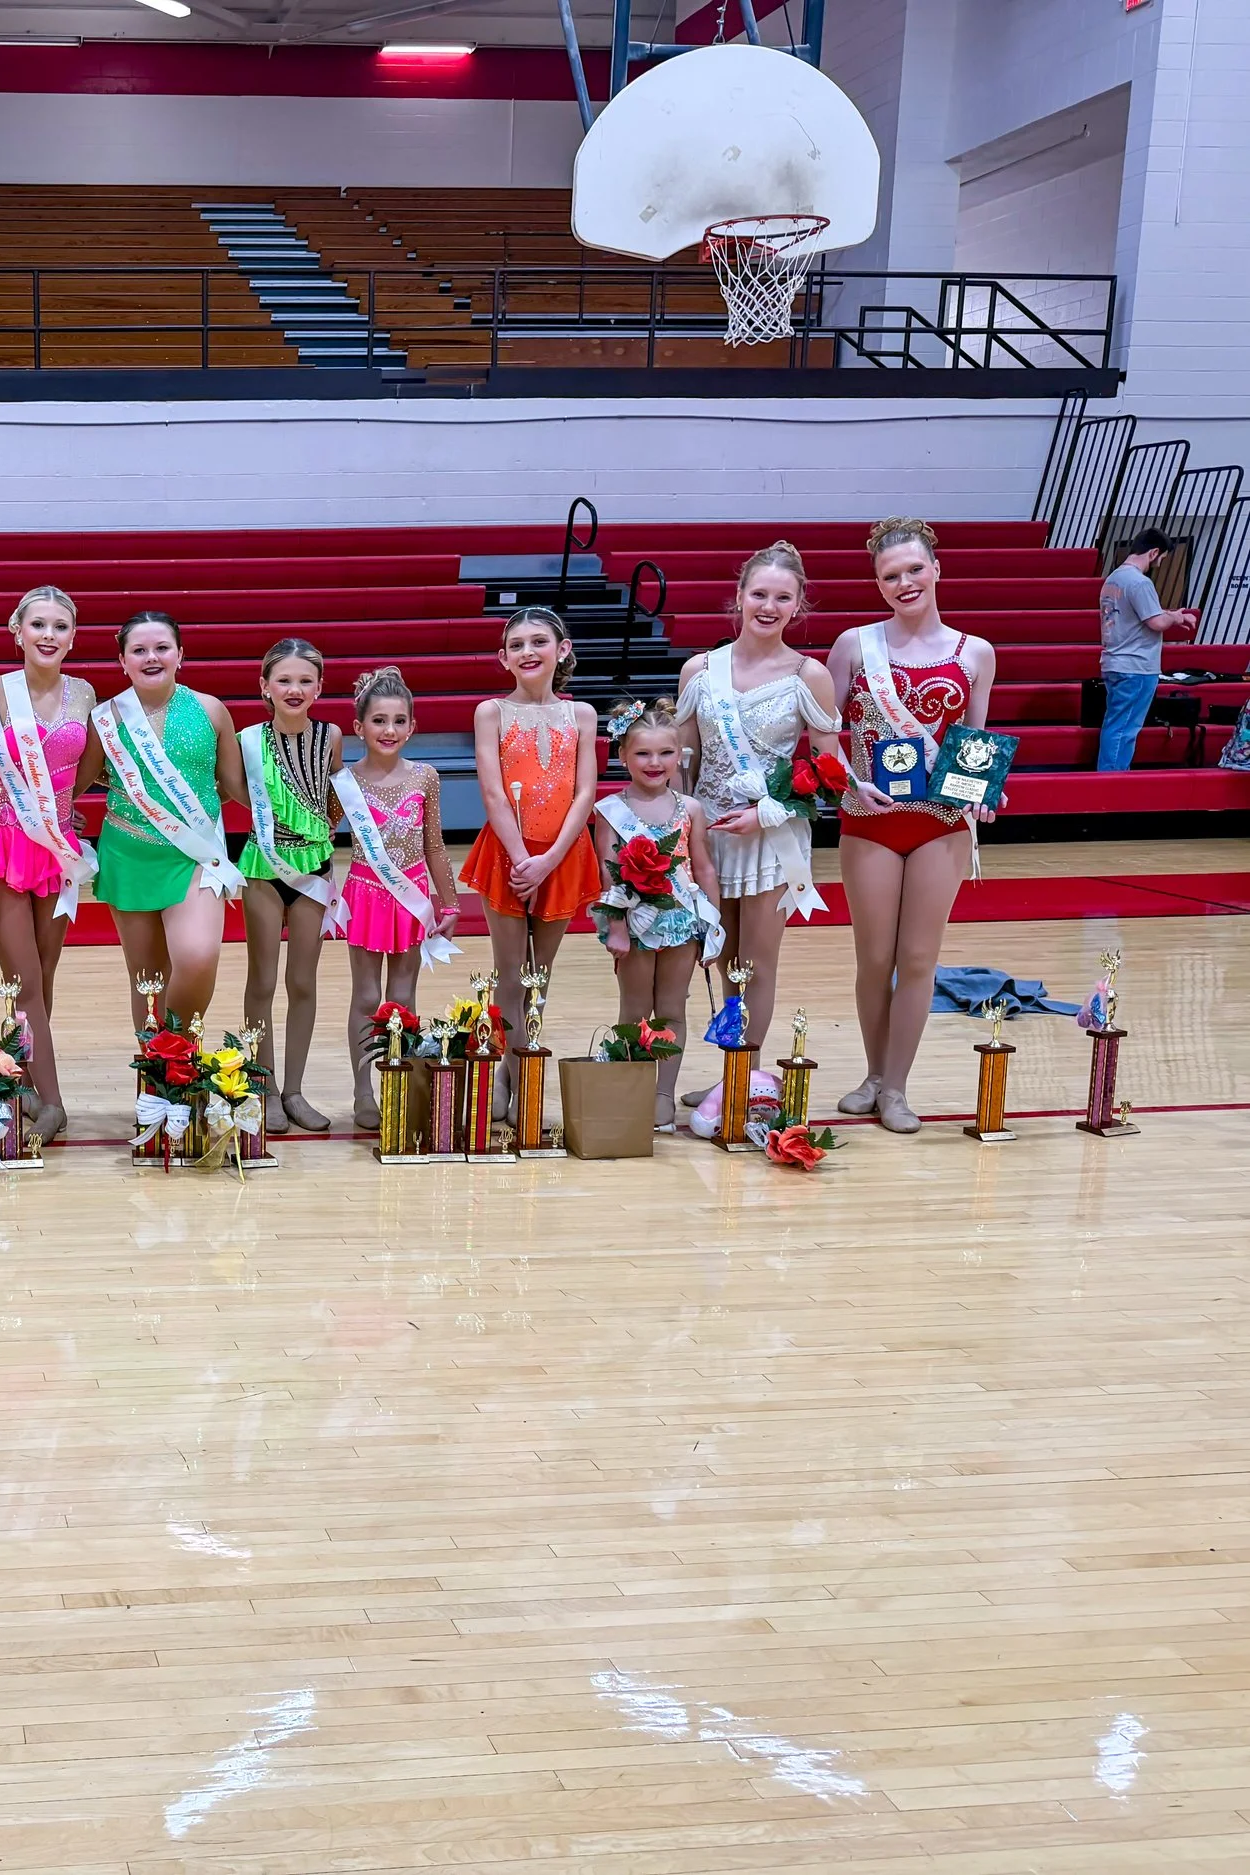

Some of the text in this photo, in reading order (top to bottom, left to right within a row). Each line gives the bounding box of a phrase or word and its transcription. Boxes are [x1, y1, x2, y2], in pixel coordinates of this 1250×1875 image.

[877, 687, 901, 723] Rainbow
[134, 727, 148, 739] 2026
[722, 713, 740, 751] Rainbow
[25, 750, 44, 788] Rainbow
[98, 716, 180, 833] 2026 Rainbow Most Beautiful 11-12
[140, 740, 166, 776] Rainbow
[3, 770, 31, 813] Sweetheart
[37, 790, 49, 813] Most
[163, 775, 198, 814] Sweetheart
[41, 815, 70, 852] Beautiful
[255, 800, 270, 838] Rainbow
[352, 810, 366, 823] 2026
[358, 824, 379, 862] Rainbow
